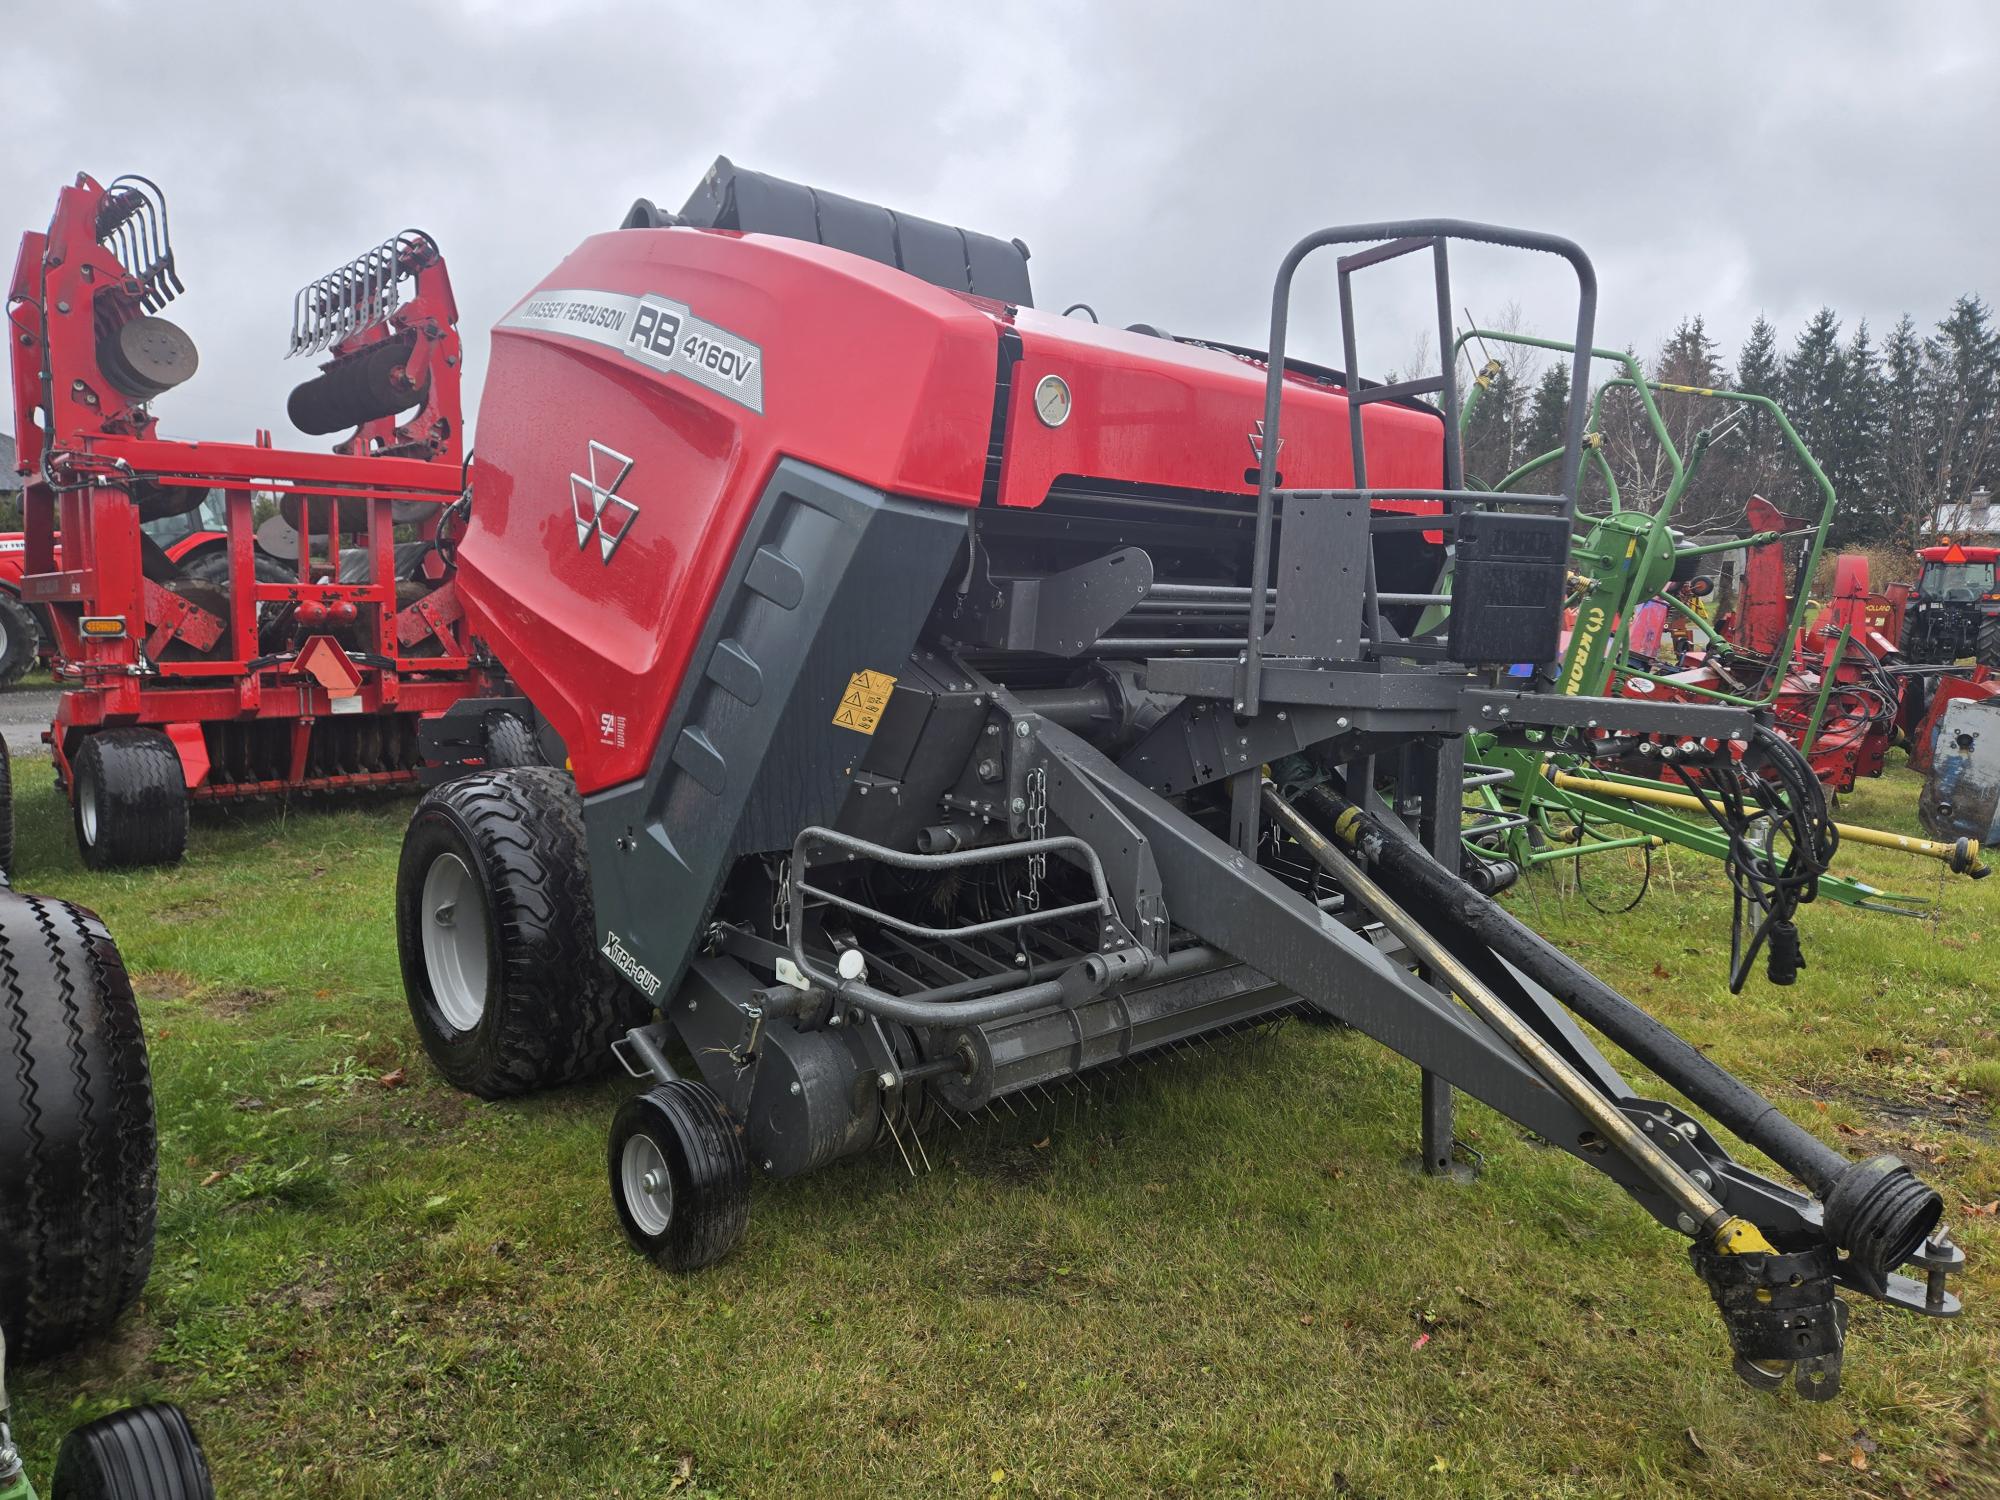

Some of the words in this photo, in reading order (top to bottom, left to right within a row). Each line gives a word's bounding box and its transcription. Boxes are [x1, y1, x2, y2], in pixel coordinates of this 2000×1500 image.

[522, 302, 567, 319] MASSEY
[563, 302, 628, 332] FERGUSON
[629, 304, 681, 357] RB
[683, 335, 753, 382] 4160V
[1565, 632, 1593, 696] KRON
[601, 930, 661, 996] XTRA-CUT
